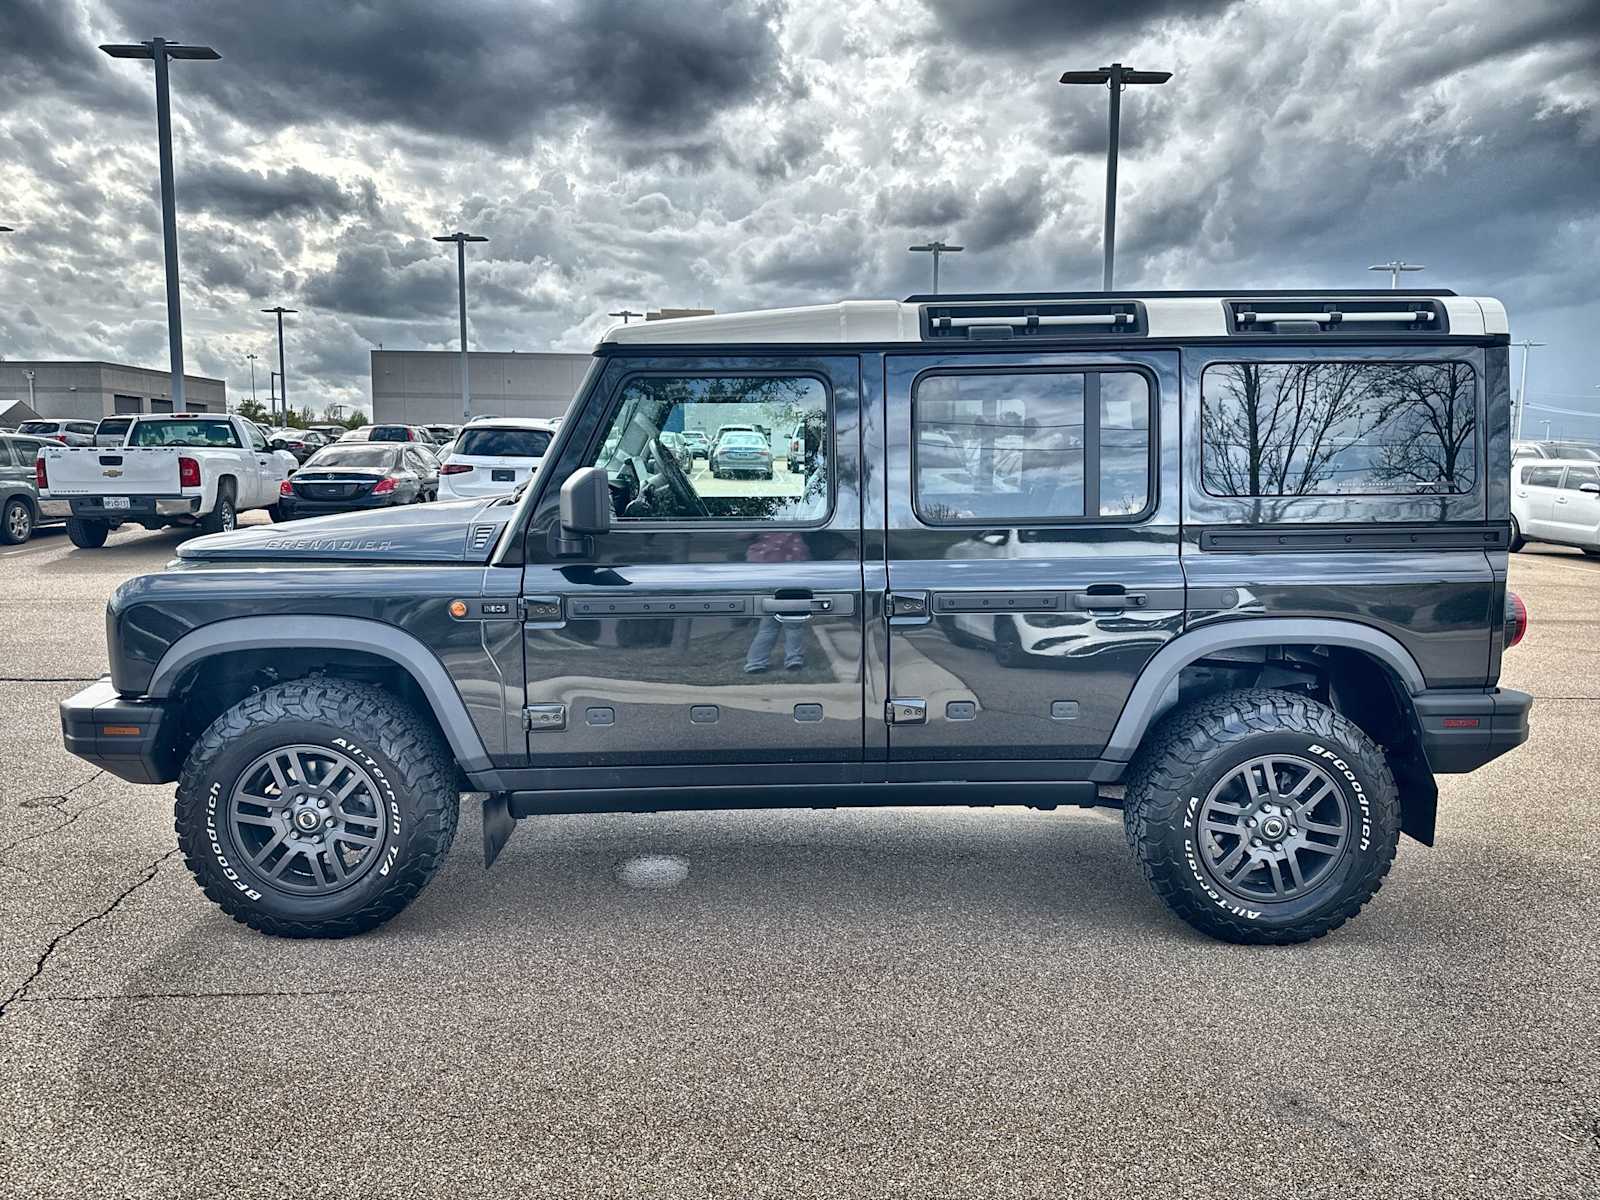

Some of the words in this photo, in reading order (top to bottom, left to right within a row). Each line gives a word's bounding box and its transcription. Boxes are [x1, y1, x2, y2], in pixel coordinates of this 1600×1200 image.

[265, 540, 392, 551] GRENADIER
[483, 605, 506, 613] INEOS
[331, 737, 401, 835] All-Terrain
[380, 845, 400, 877] T/A
[1184, 796, 1199, 829] T/A
[1307, 744, 1371, 851] BFGoodrich
[206, 782, 262, 902] BFGoodrich
[1184, 840, 1262, 920] All-Terrain
